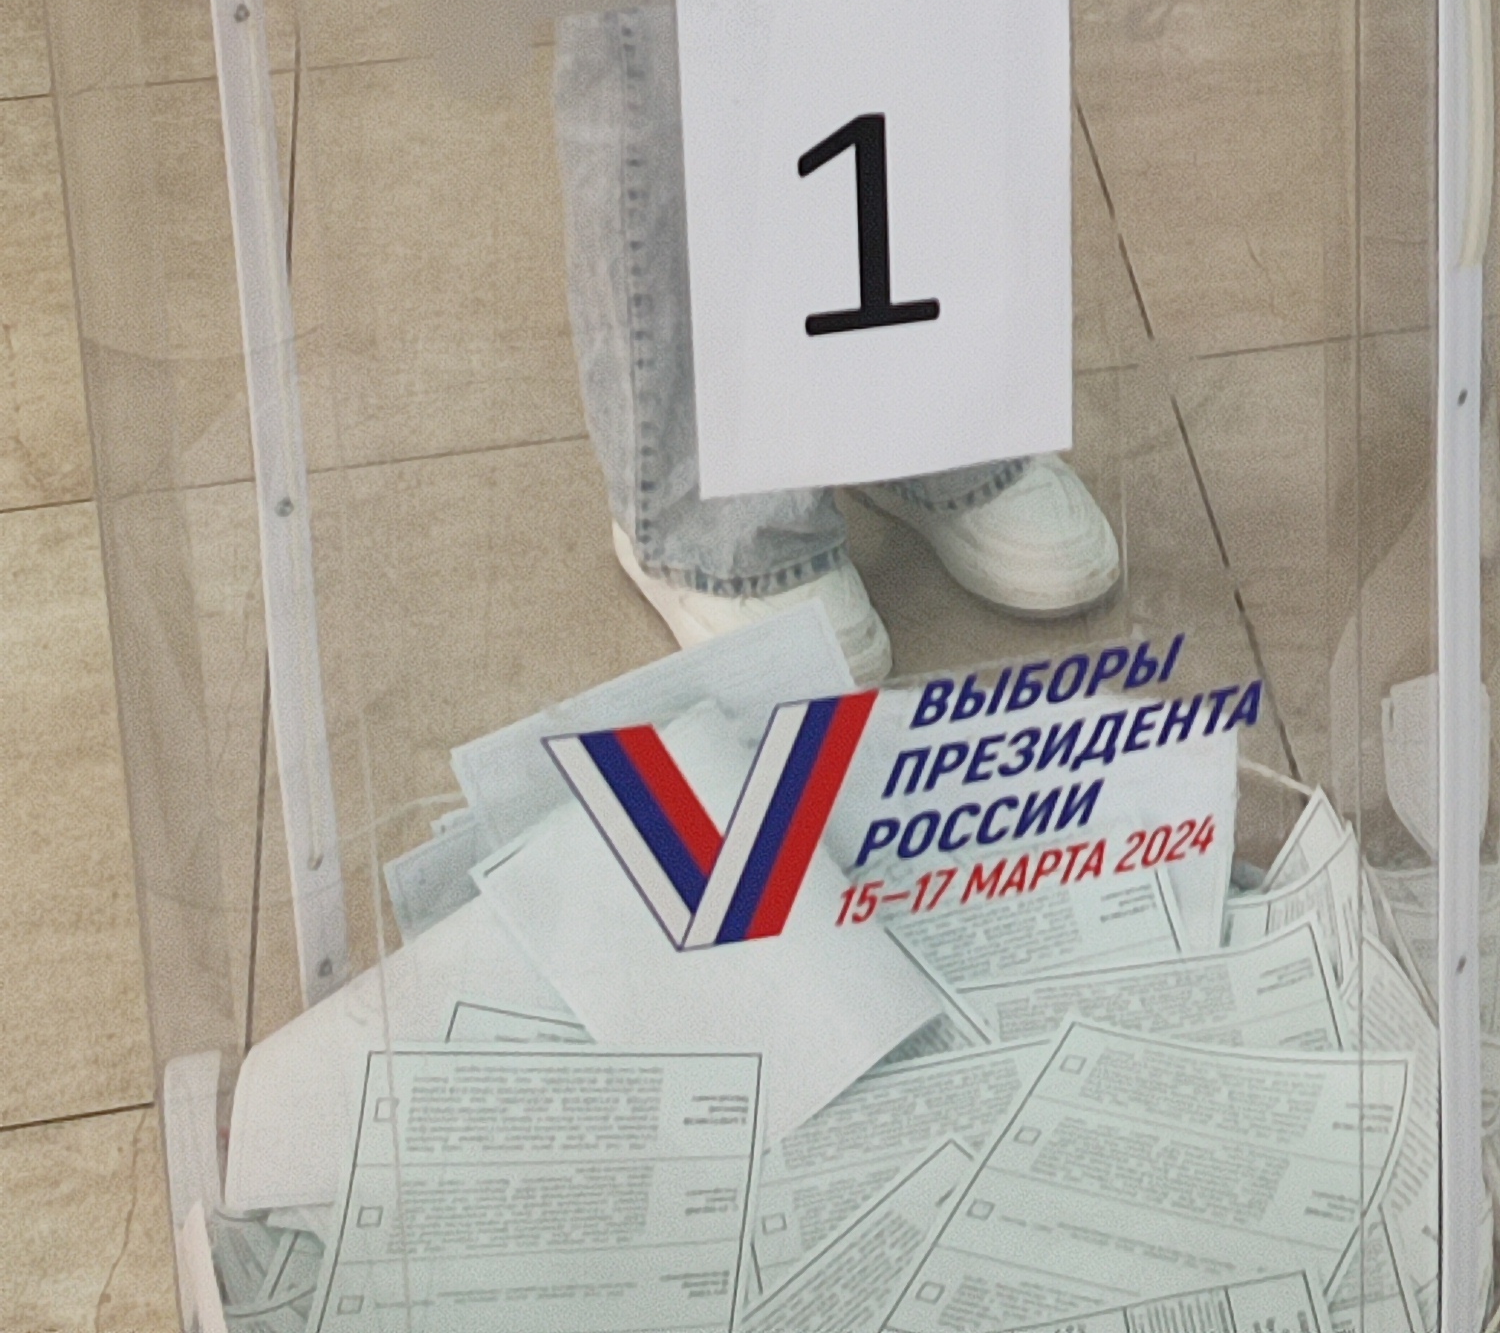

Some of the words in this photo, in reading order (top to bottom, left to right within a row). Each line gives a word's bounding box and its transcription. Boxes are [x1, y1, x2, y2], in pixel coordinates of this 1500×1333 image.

[797, 112, 941, 338] 1
[909, 633, 1187, 730] ВЫБОРЫ
[881, 678, 1264, 801] ПРЕЗИДЕНТА
[854, 777, 1106, 868] РОССИИ
[960, 838, 1109, 905] МАРТА
[1112, 814, 1217, 876] 2024
